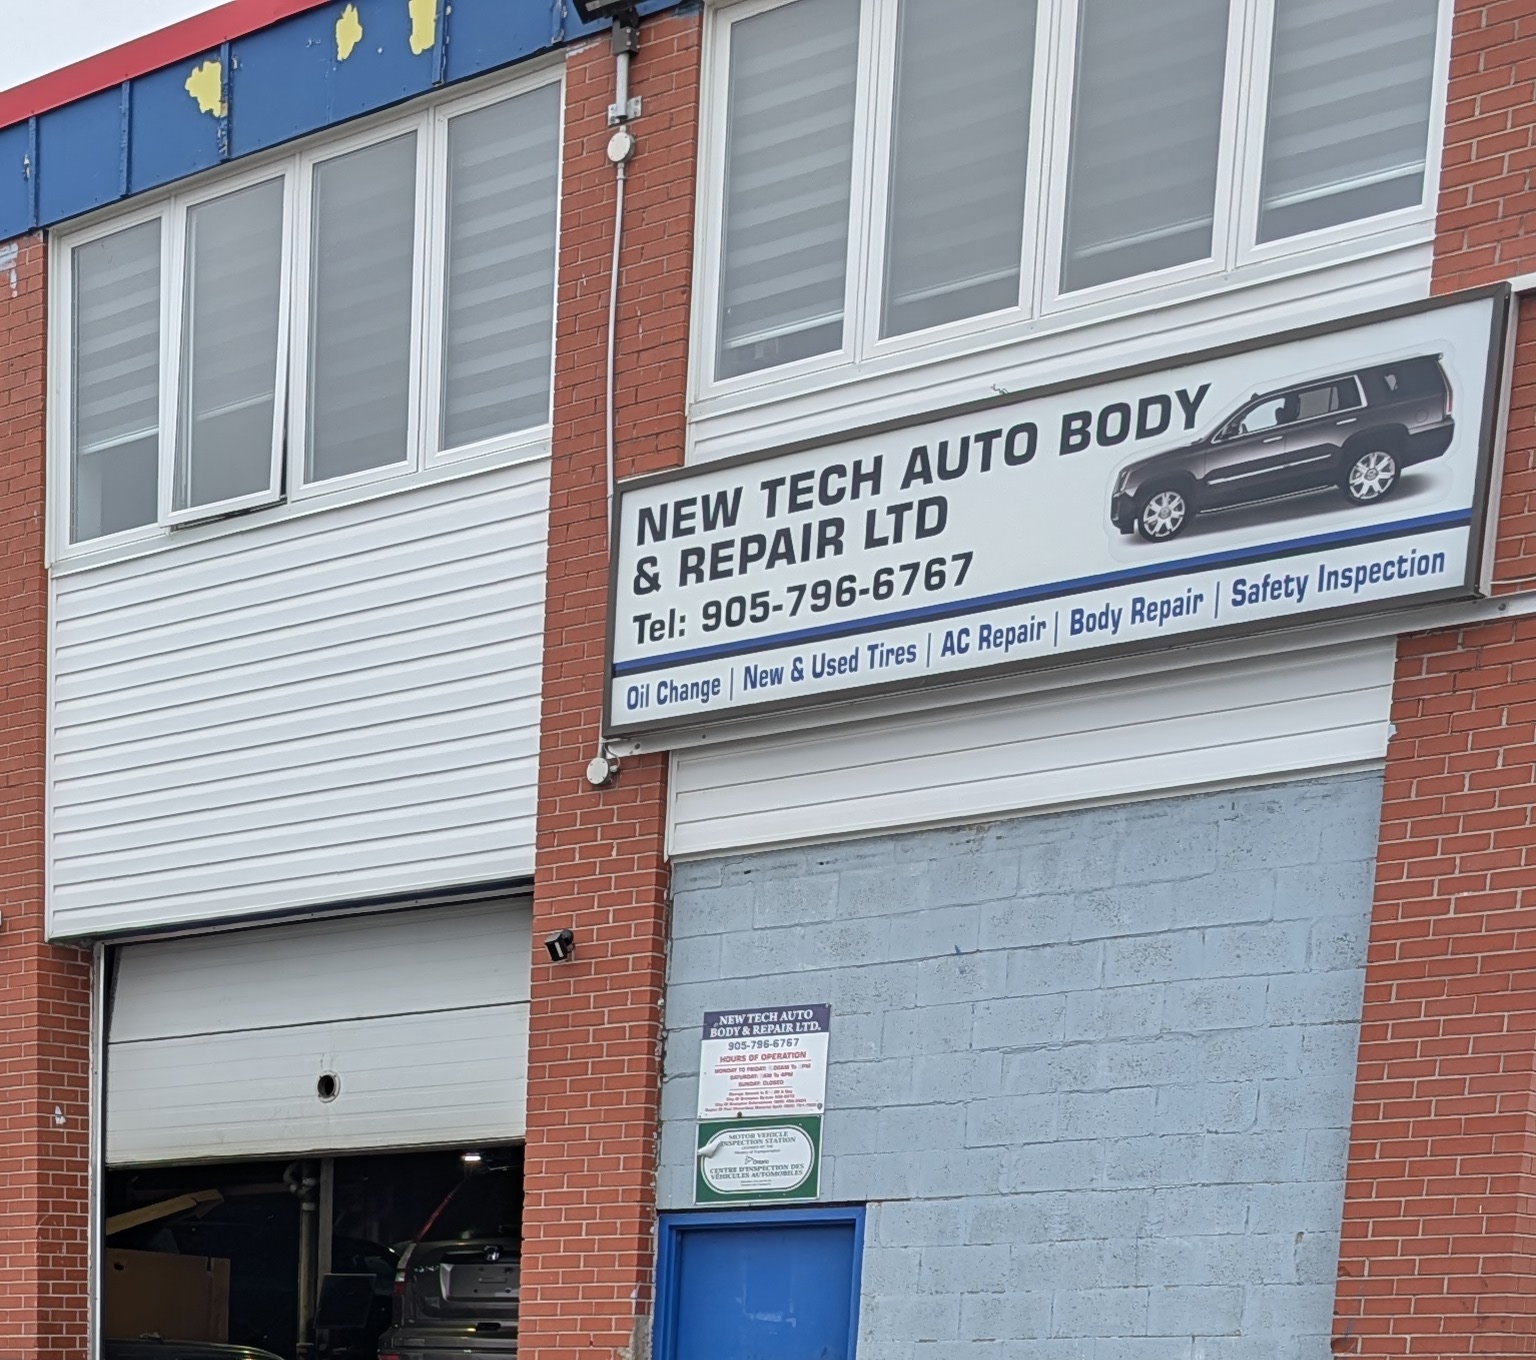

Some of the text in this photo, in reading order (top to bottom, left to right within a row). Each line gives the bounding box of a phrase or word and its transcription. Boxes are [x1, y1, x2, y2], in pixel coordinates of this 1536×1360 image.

[637, 383, 1211, 546] NEW TECH AUTO BODY
[634, 496, 947, 595] & REPAIR LTD
[1232, 549, 1444, 607] Safety Inspection
[633, 551, 973, 644] Tel: 905-796-6767
[1070, 588, 1203, 636] Body Repair
[941, 616, 1046, 657] AC Repair
[744, 643, 916, 690] New & Used Tires
[627, 678, 720, 710] Oil Change
[709, 1021, 821, 1038] BODY & REPAIR LTD.
[719, 1009, 813, 1026] NEW TECH AUTO
[720, 1051, 807, 1063] HOURS OF OPERATION
[728, 1038, 799, 1051] 905-796-6767
[721, 1136, 796, 1147] INSPECTION STATION
[751, 1170, 802, 1178] AUTOMOBILES
